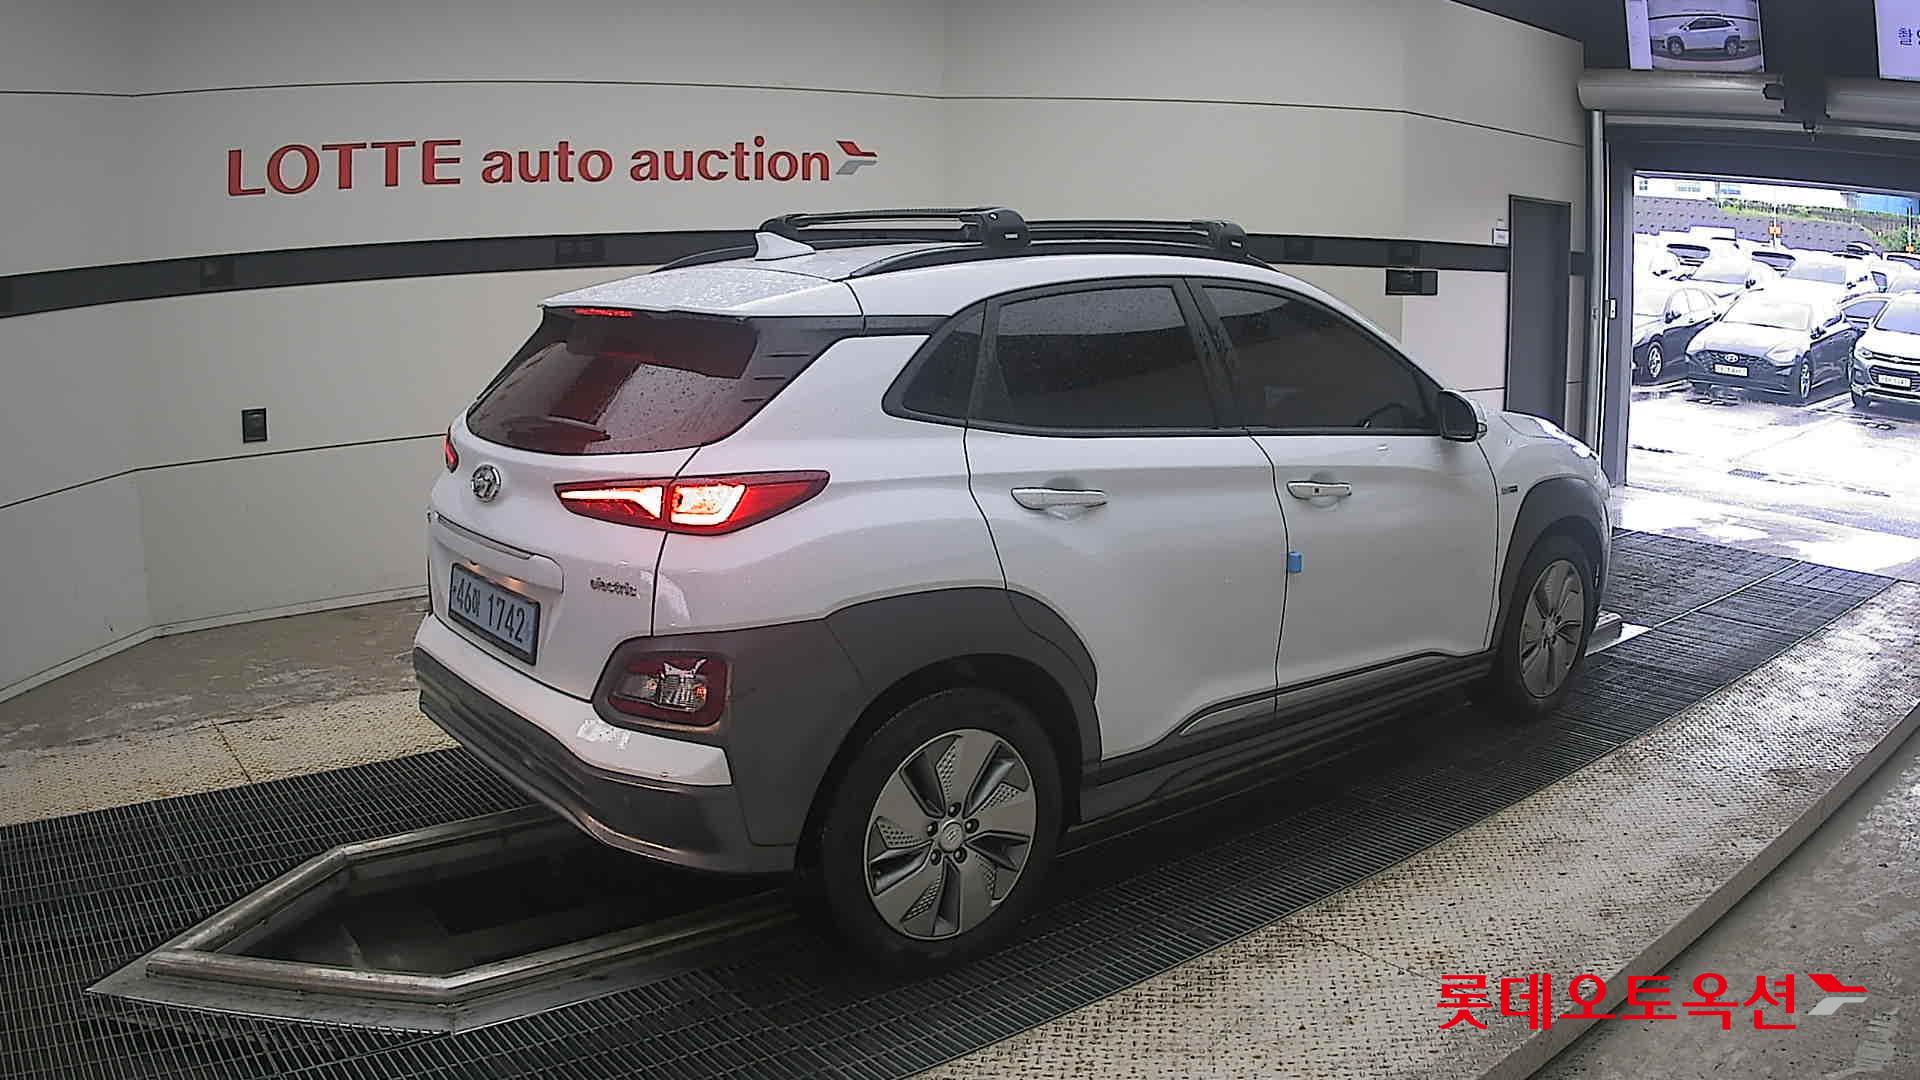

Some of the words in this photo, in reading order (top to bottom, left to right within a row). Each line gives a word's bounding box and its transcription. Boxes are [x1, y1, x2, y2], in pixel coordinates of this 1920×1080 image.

[228, 139, 462, 197] LOTTE
[481, 140, 614, 184] auto
[629, 135, 831, 182] auction
[487, 592, 526, 644] 1742
